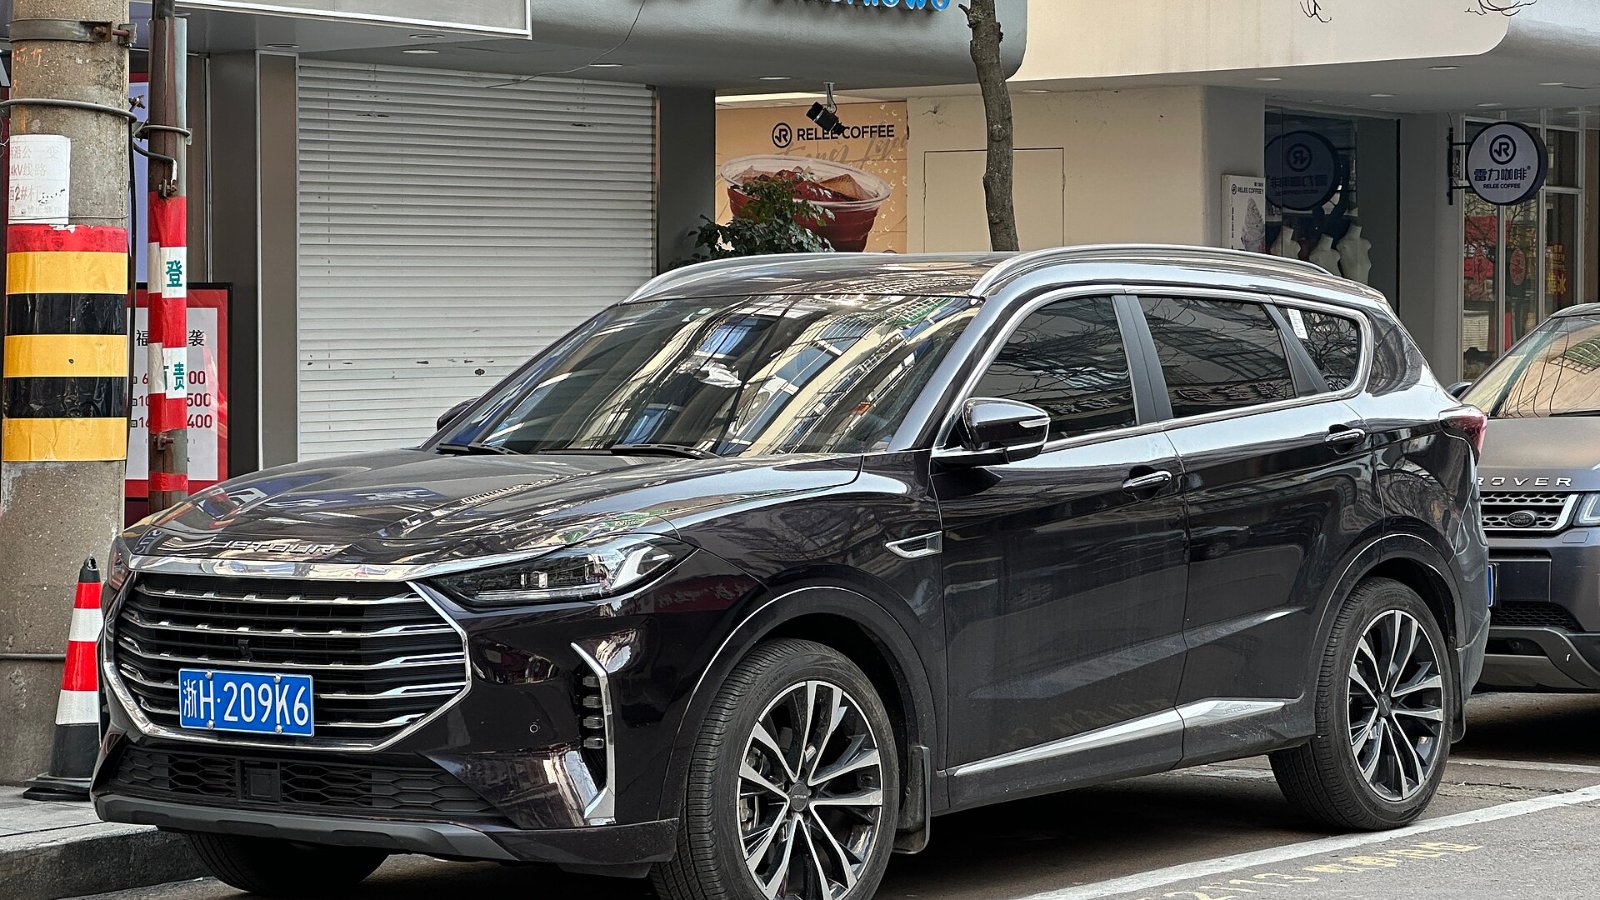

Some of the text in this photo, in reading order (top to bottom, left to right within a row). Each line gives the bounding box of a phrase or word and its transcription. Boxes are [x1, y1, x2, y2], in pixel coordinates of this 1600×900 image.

[841, 125, 895, 139] COFFEE
[1474, 168, 1527, 181] 雷力咖啡
[165, 260, 183, 287] 登
